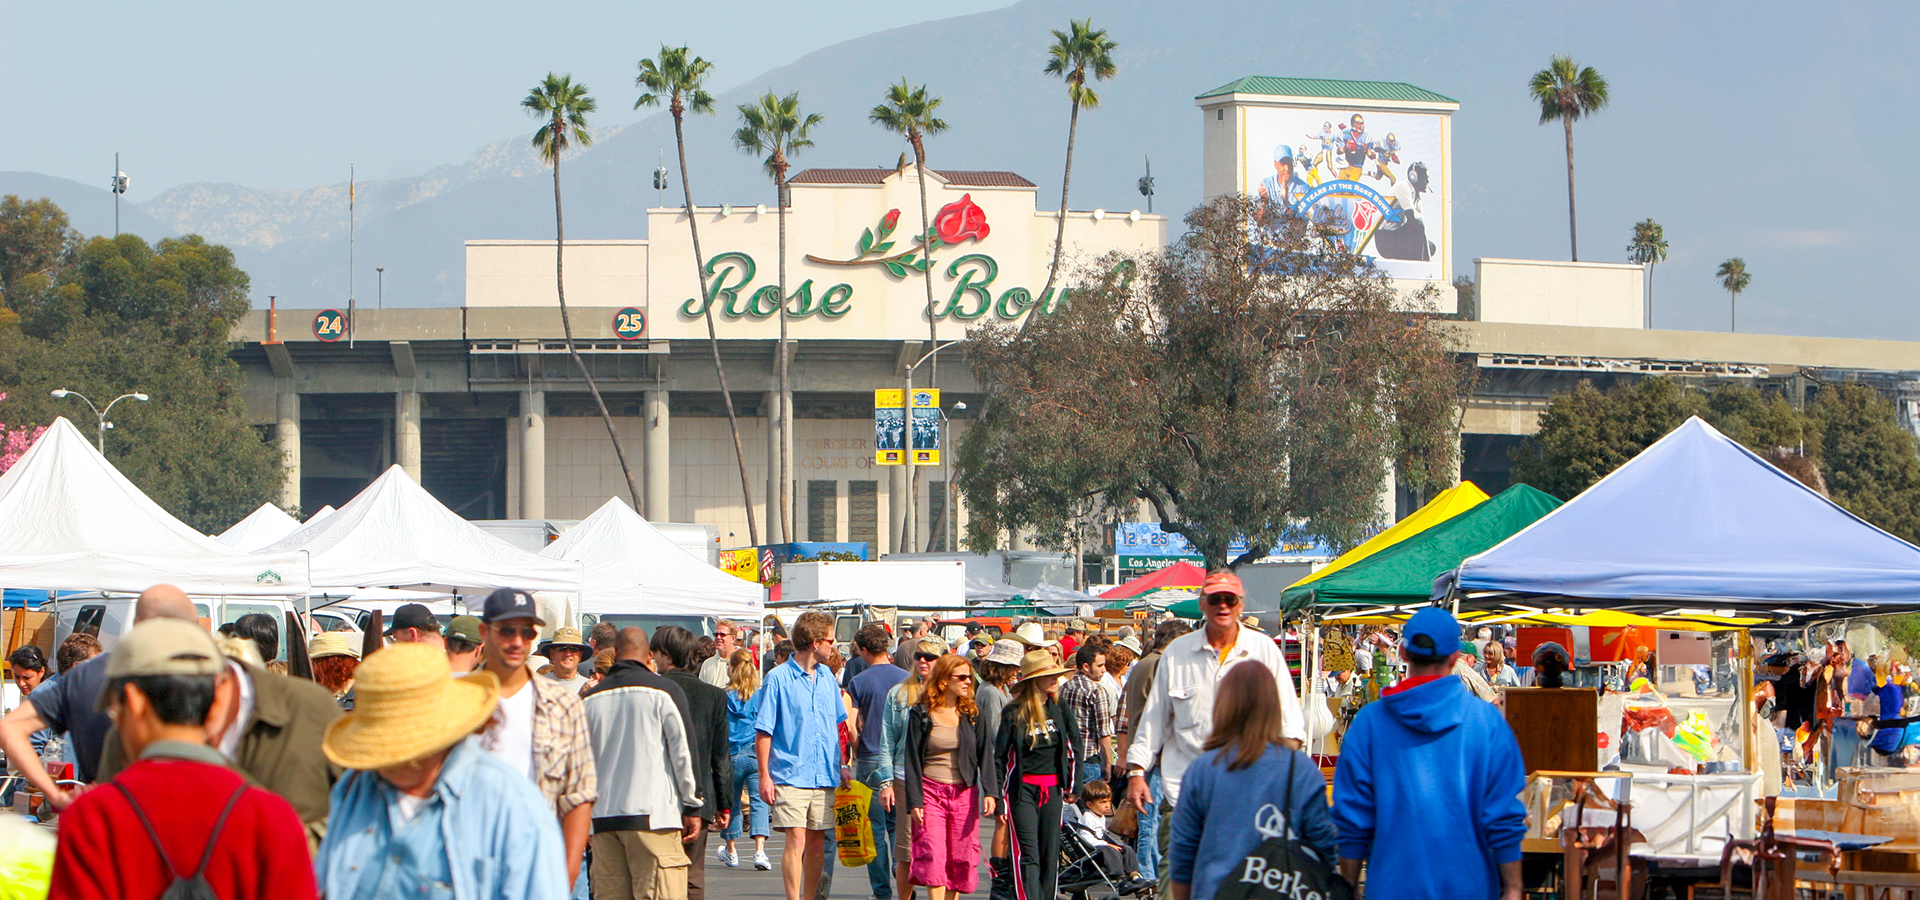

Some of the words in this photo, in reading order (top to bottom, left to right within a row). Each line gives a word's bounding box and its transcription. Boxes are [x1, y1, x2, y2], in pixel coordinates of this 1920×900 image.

[1306, 186, 1328, 202] YEARS
[1328, 183, 1338, 191] AT
[682, 251, 853, 318] Rose
[317, 315, 343, 334] 24
[617, 313, 643, 332] 25
[806, 438, 868, 450] CHRYSLER
[801, 456, 852, 469] COURT
[855, 456, 876, 469] OF
[1122, 532, 1137, 546] 12
[1150, 532, 1169, 546] 25
[1128, 557, 1144, 568] Los
[1144, 557, 1177, 569] Angeles
[1239, 855, 1331, 900] Berke
